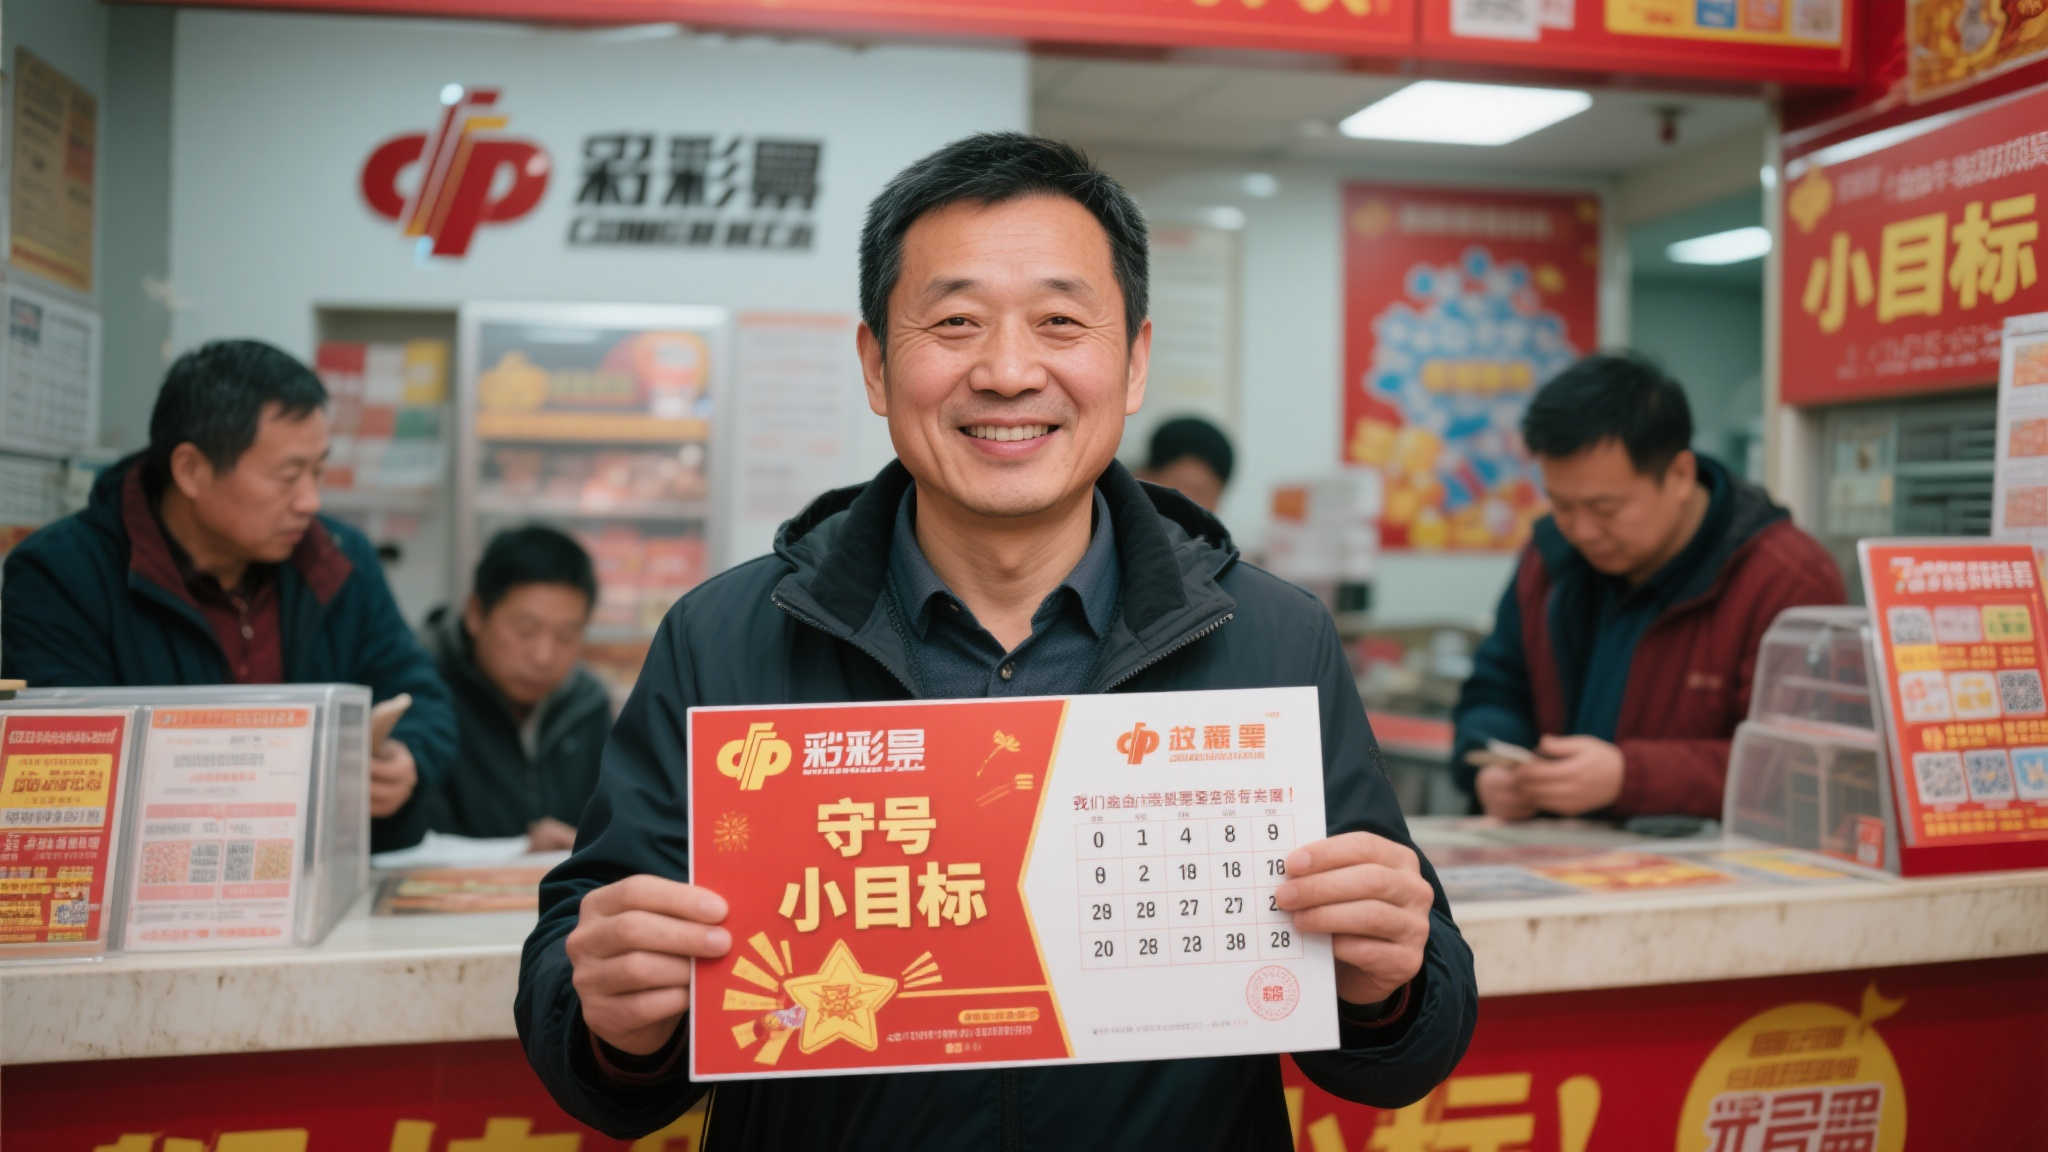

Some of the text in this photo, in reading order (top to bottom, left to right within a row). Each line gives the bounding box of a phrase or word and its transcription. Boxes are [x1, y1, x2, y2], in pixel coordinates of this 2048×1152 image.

[1803, 193, 2038, 333] 小目标
[817, 796, 937, 857] 守号
[1093, 823, 1279, 849] 0 1 4 8 9
[1139, 864, 1150, 882] 2
[778, 861, 988, 933] 小目标
[1179, 899, 1199, 916] 27
[1224, 897, 1243, 914] 27
[1268, 895, 1278, 912] 2
[1094, 940, 1114, 958] 20
[1270, 931, 1290, 949] 28
